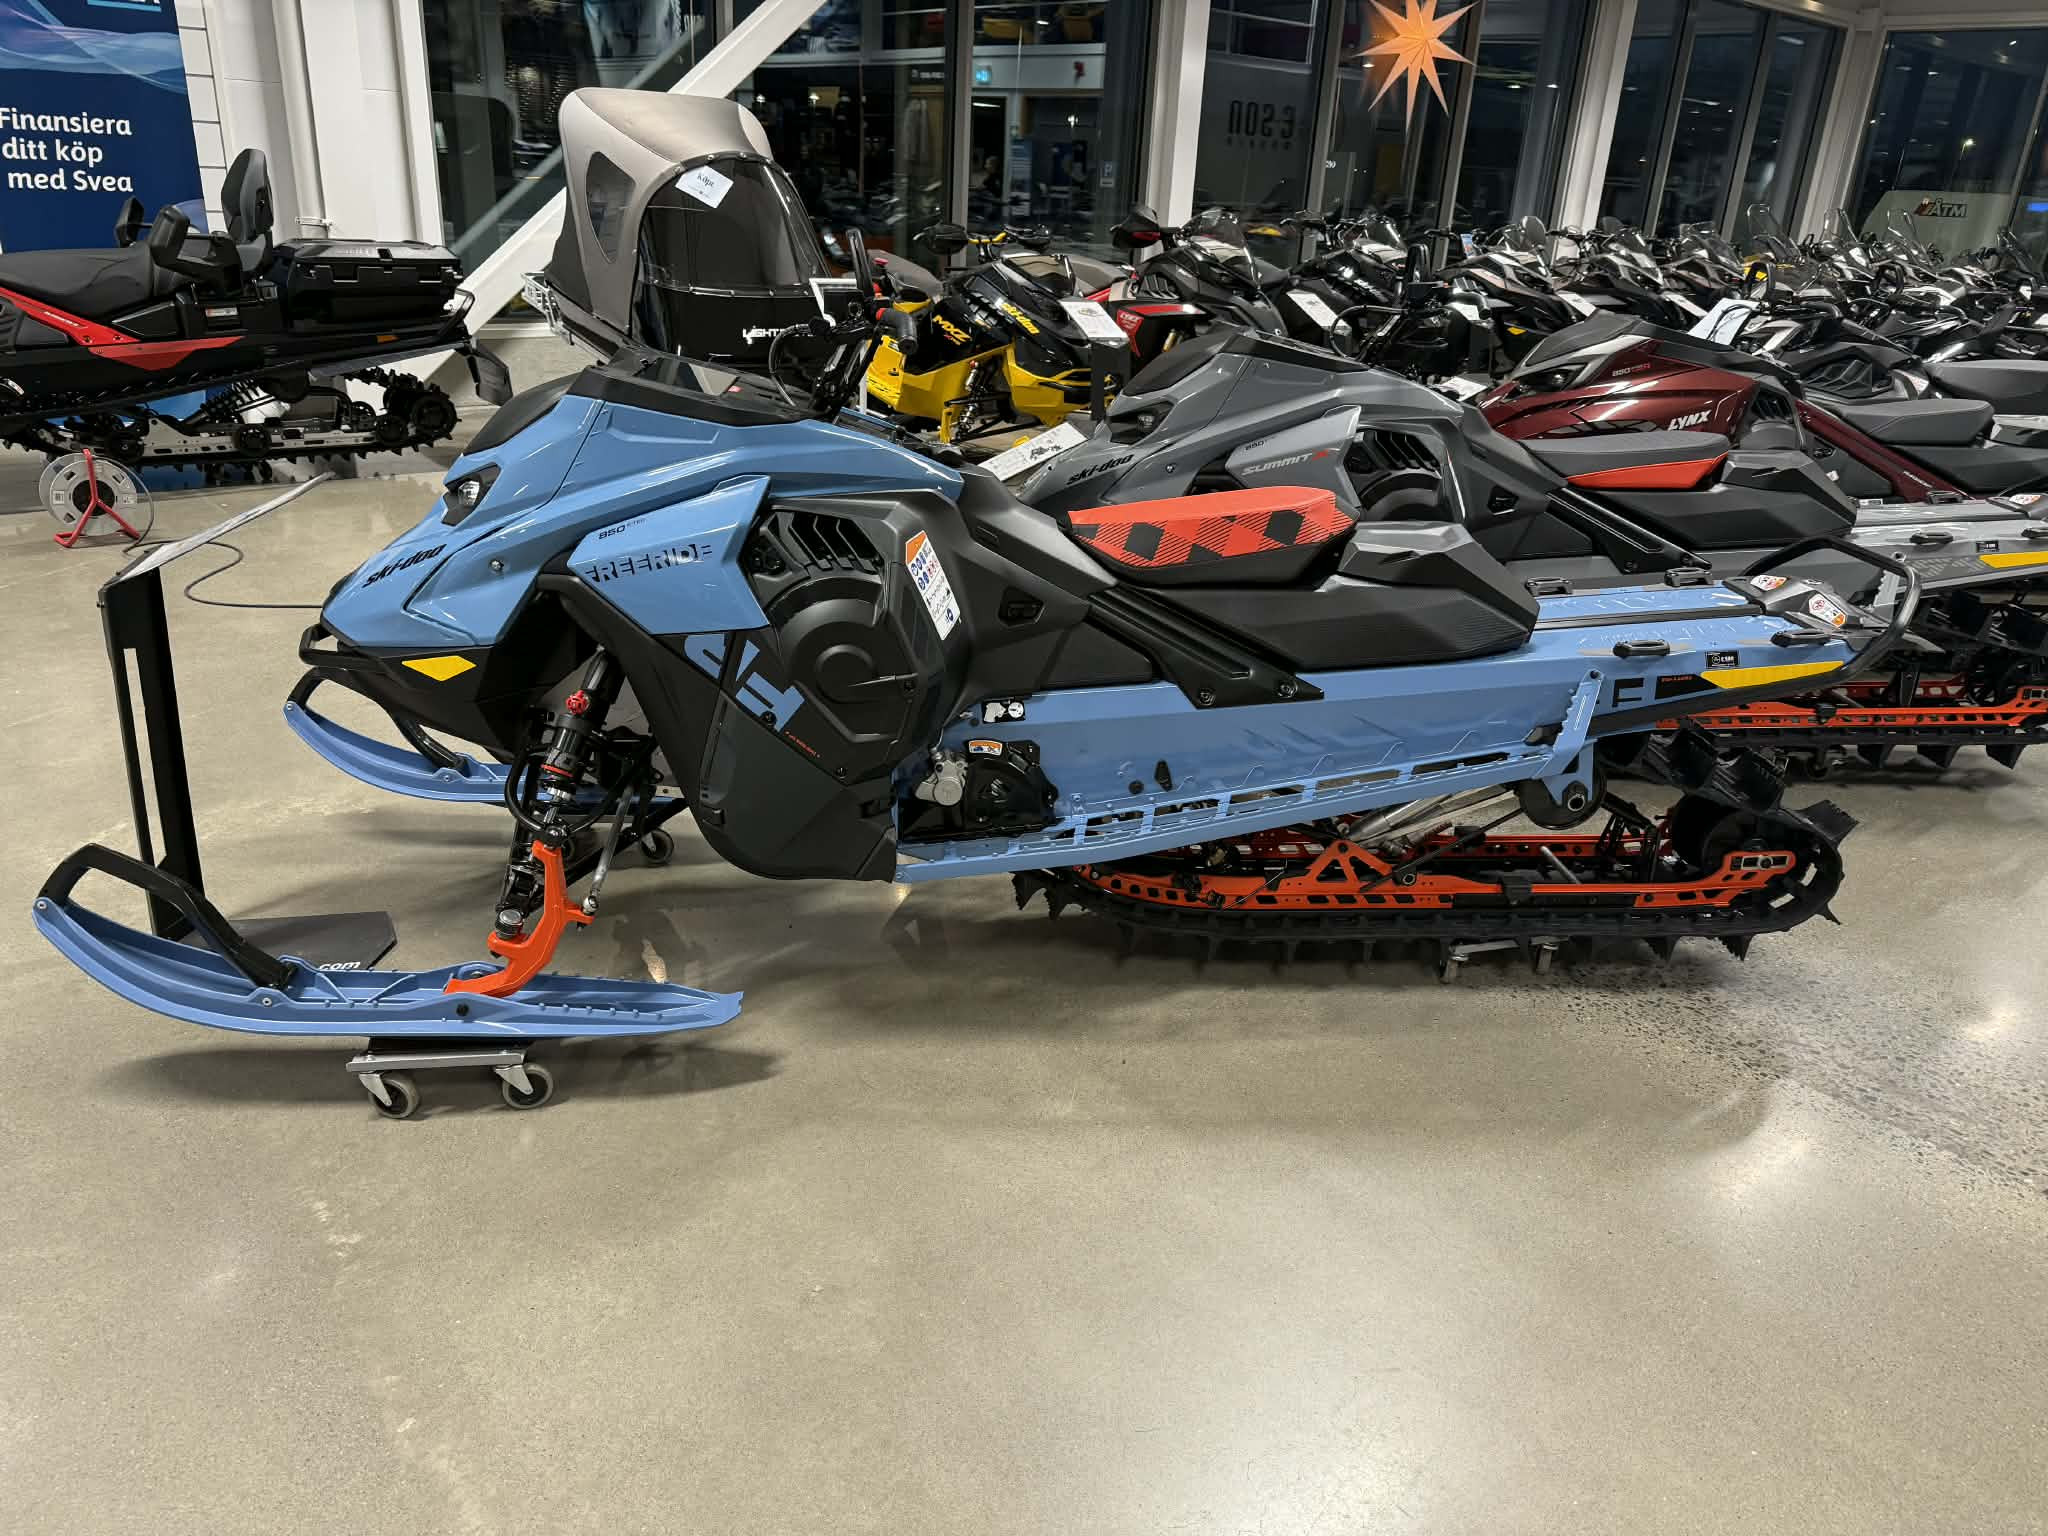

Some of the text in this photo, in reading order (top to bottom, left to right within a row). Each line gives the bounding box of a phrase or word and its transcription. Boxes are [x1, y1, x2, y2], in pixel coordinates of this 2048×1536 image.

[0, 107, 132, 135] Finansiera
[2, 136, 103, 168] ditt köp
[7, 168, 134, 192] med Svea
[1668, 410, 1712, 431] LYNX
[1066, 454, 1135, 486] ski-doo
[1241, 452, 1313, 477] SUMMIT
[598, 525, 626, 540] 850
[362, 543, 448, 589] ski-doo
[584, 543, 714, 583] FREERIDE
